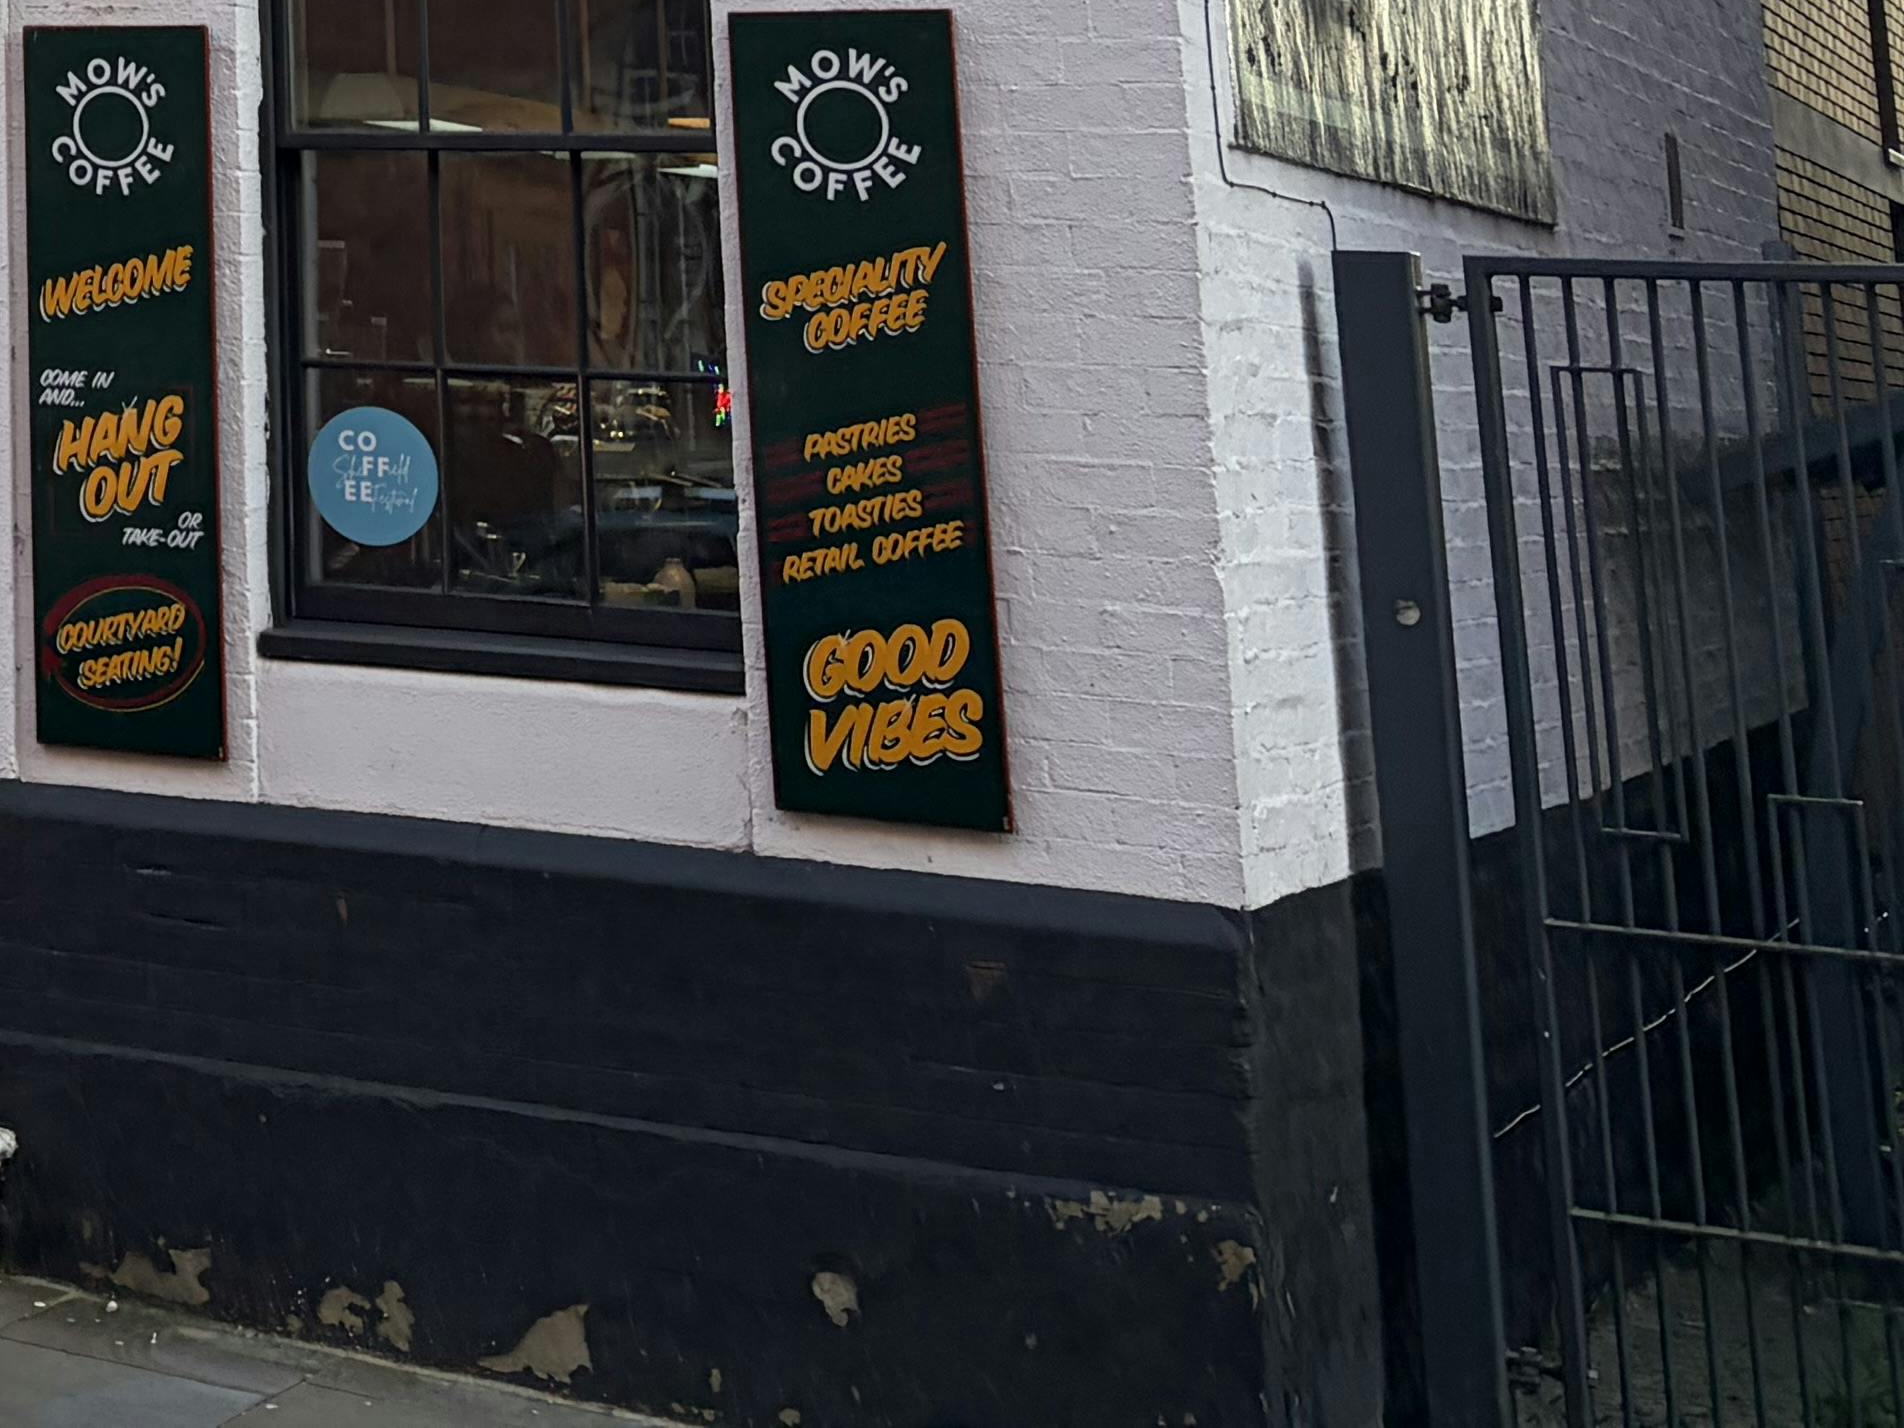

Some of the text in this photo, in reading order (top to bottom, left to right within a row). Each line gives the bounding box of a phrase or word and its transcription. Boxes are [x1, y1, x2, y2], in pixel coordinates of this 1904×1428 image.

[55, 56, 167, 108] MOW'S
[773, 47, 909, 104] MOW'S
[51, 135, 174, 195] COFFEE
[770, 135, 922, 202] COFFEE
[40, 244, 194, 323] WELCOME
[759, 241, 948, 321] SPECIALITY
[803, 289, 929, 354] COFFEE
[40, 369, 115, 390] COME IN
[52, 394, 185, 476] HANG
[803, 413, 917, 463] PASTRIES
[80, 450, 185, 523] OUT
[826, 454, 903, 495] CAKES
[122, 527, 204, 551] TAKE-OUT
[177, 511, 203, 530] OR
[808, 489, 923, 538] TOASTIES
[781, 519, 965, 584] RETAIL COFFEE
[56, 603, 186, 655] COURTYARD
[77, 636, 183, 690] SEATING!
[802, 618, 971, 704] GOOD
[804, 688, 984, 777] VIBES
